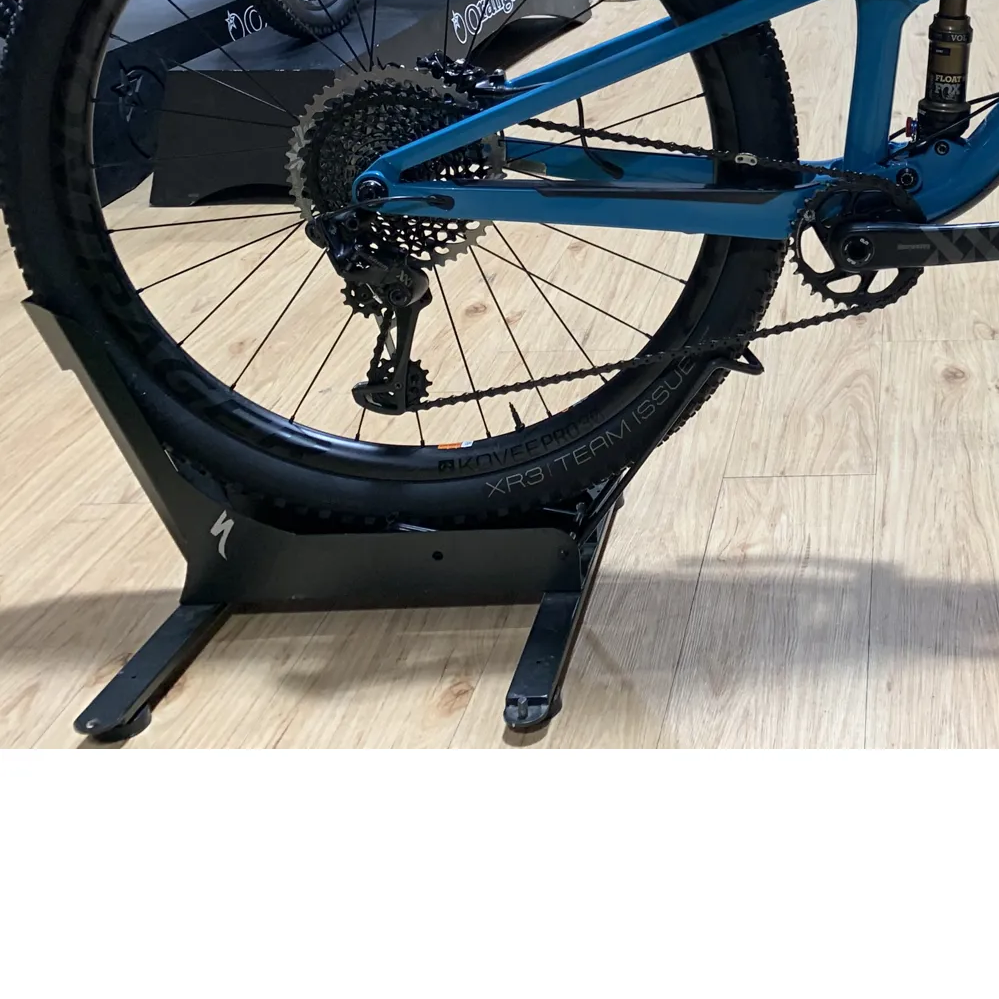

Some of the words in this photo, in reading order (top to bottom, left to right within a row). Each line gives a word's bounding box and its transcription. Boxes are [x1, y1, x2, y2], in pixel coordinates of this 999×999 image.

[935, 74, 962, 83] FLOAT
[934, 83, 960, 100] FOX
[485, 467, 545, 498] XR3
[554, 419, 632, 472] TEAM
[630, 354, 697, 425] ISSUE
